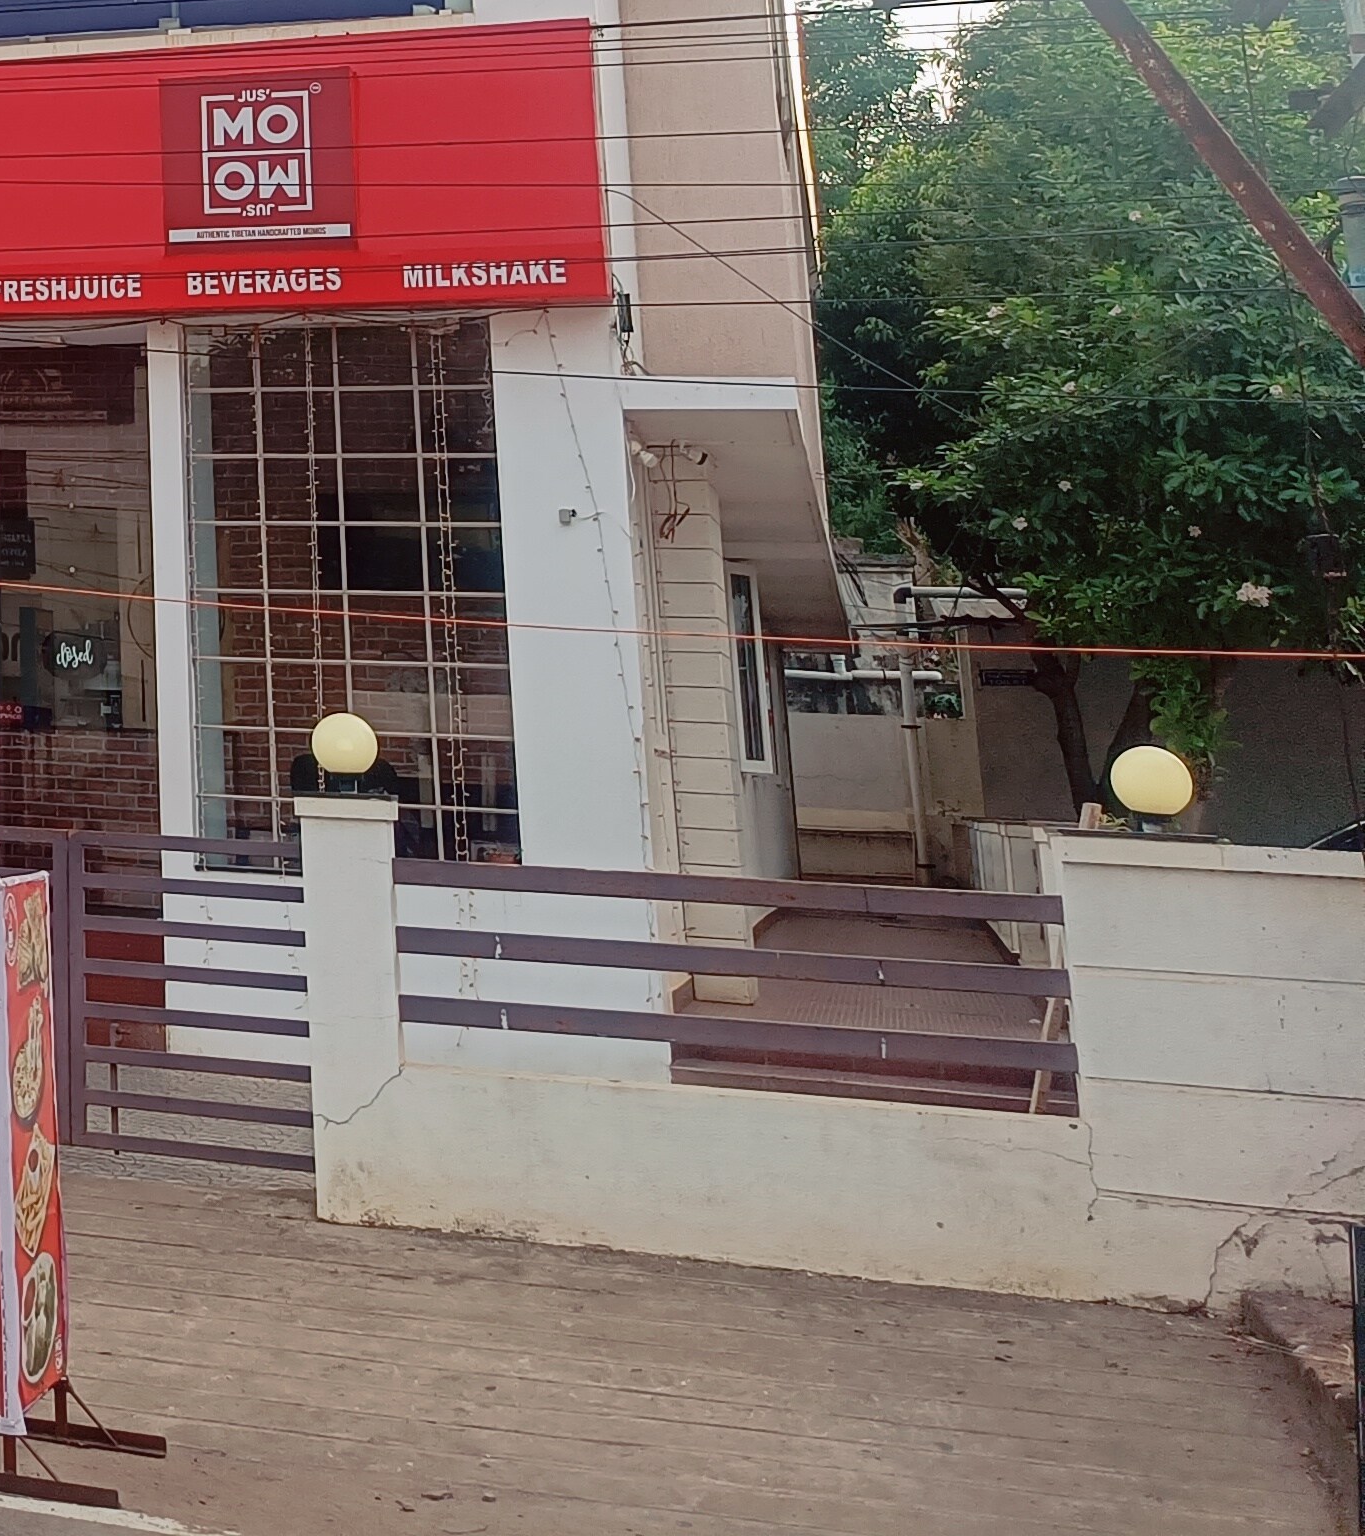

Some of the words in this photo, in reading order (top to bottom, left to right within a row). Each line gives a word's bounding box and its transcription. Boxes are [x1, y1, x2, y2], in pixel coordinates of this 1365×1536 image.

[212, 104, 299, 146] MO
[196, 230, 230, 240] AUTHENTIC
[231, 229, 257, 239] TIBETAN
[257, 227, 302, 238] HANDCRAFTED
[187, 267, 342, 296] BEVERAGES
[402, 259, 568, 288] MILKSHAKE
[56, 639, 94, 668] closed
